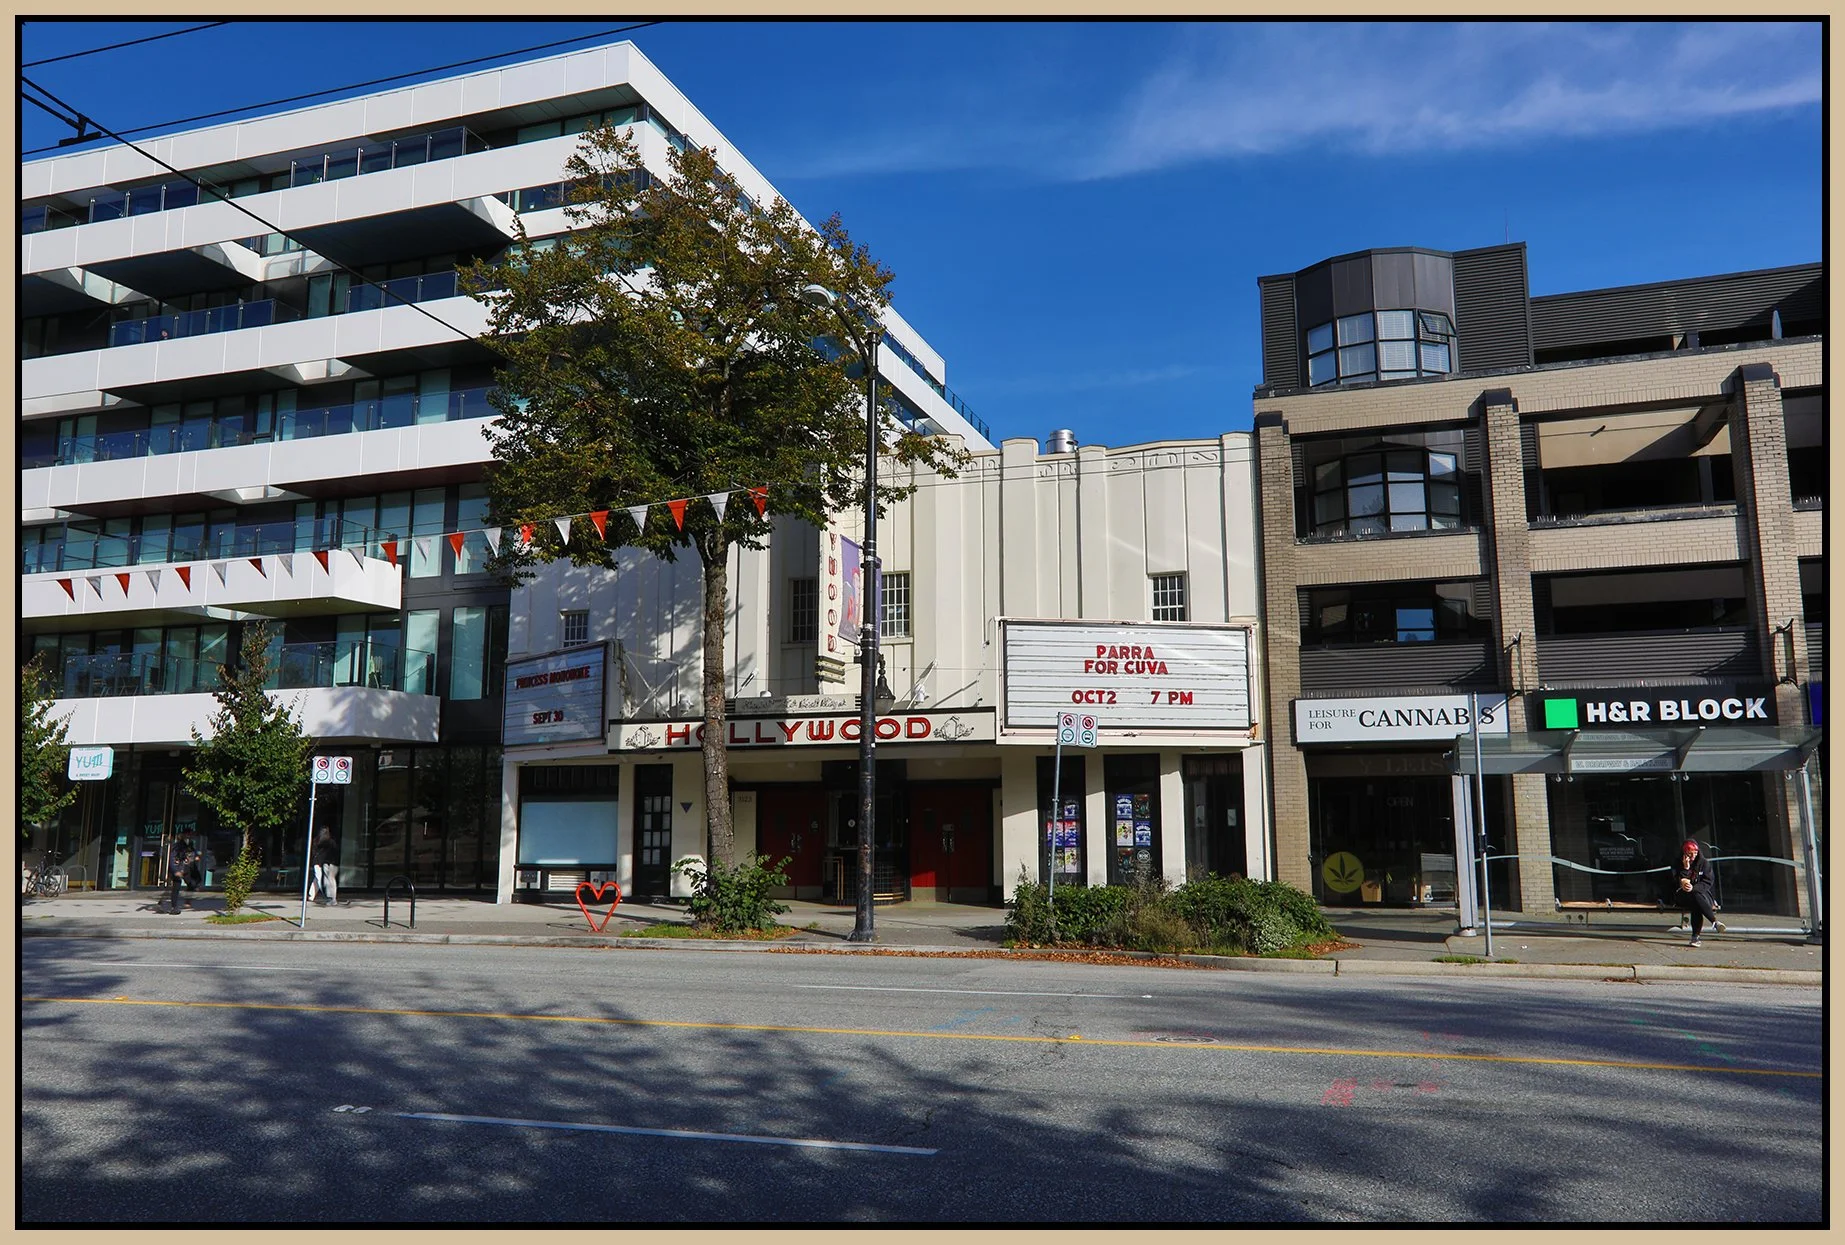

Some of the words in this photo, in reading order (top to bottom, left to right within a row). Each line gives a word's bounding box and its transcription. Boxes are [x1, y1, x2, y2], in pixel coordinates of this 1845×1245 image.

[1096, 644, 1155, 660] PARRA
[1084, 659, 1119, 675] FOR
[1123, 660, 1169, 675] CUVA
[1071, 689, 1118, 705] OCT2
[1151, 690, 1161, 704] 7
[1168, 690, 1194, 706] PM
[532, 710, 553, 725] SEPT
[553, 709, 564, 722] 30
[1309, 708, 1357, 719] LEISURE
[1358, 707, 1496, 728] CANNABS
[1586, 700, 1651, 723] H&R
[1659, 697, 1768, 721] BLOCK
[665, 717, 933, 746] HLLYWOOD
[1309, 720, 1333, 730] FOR
